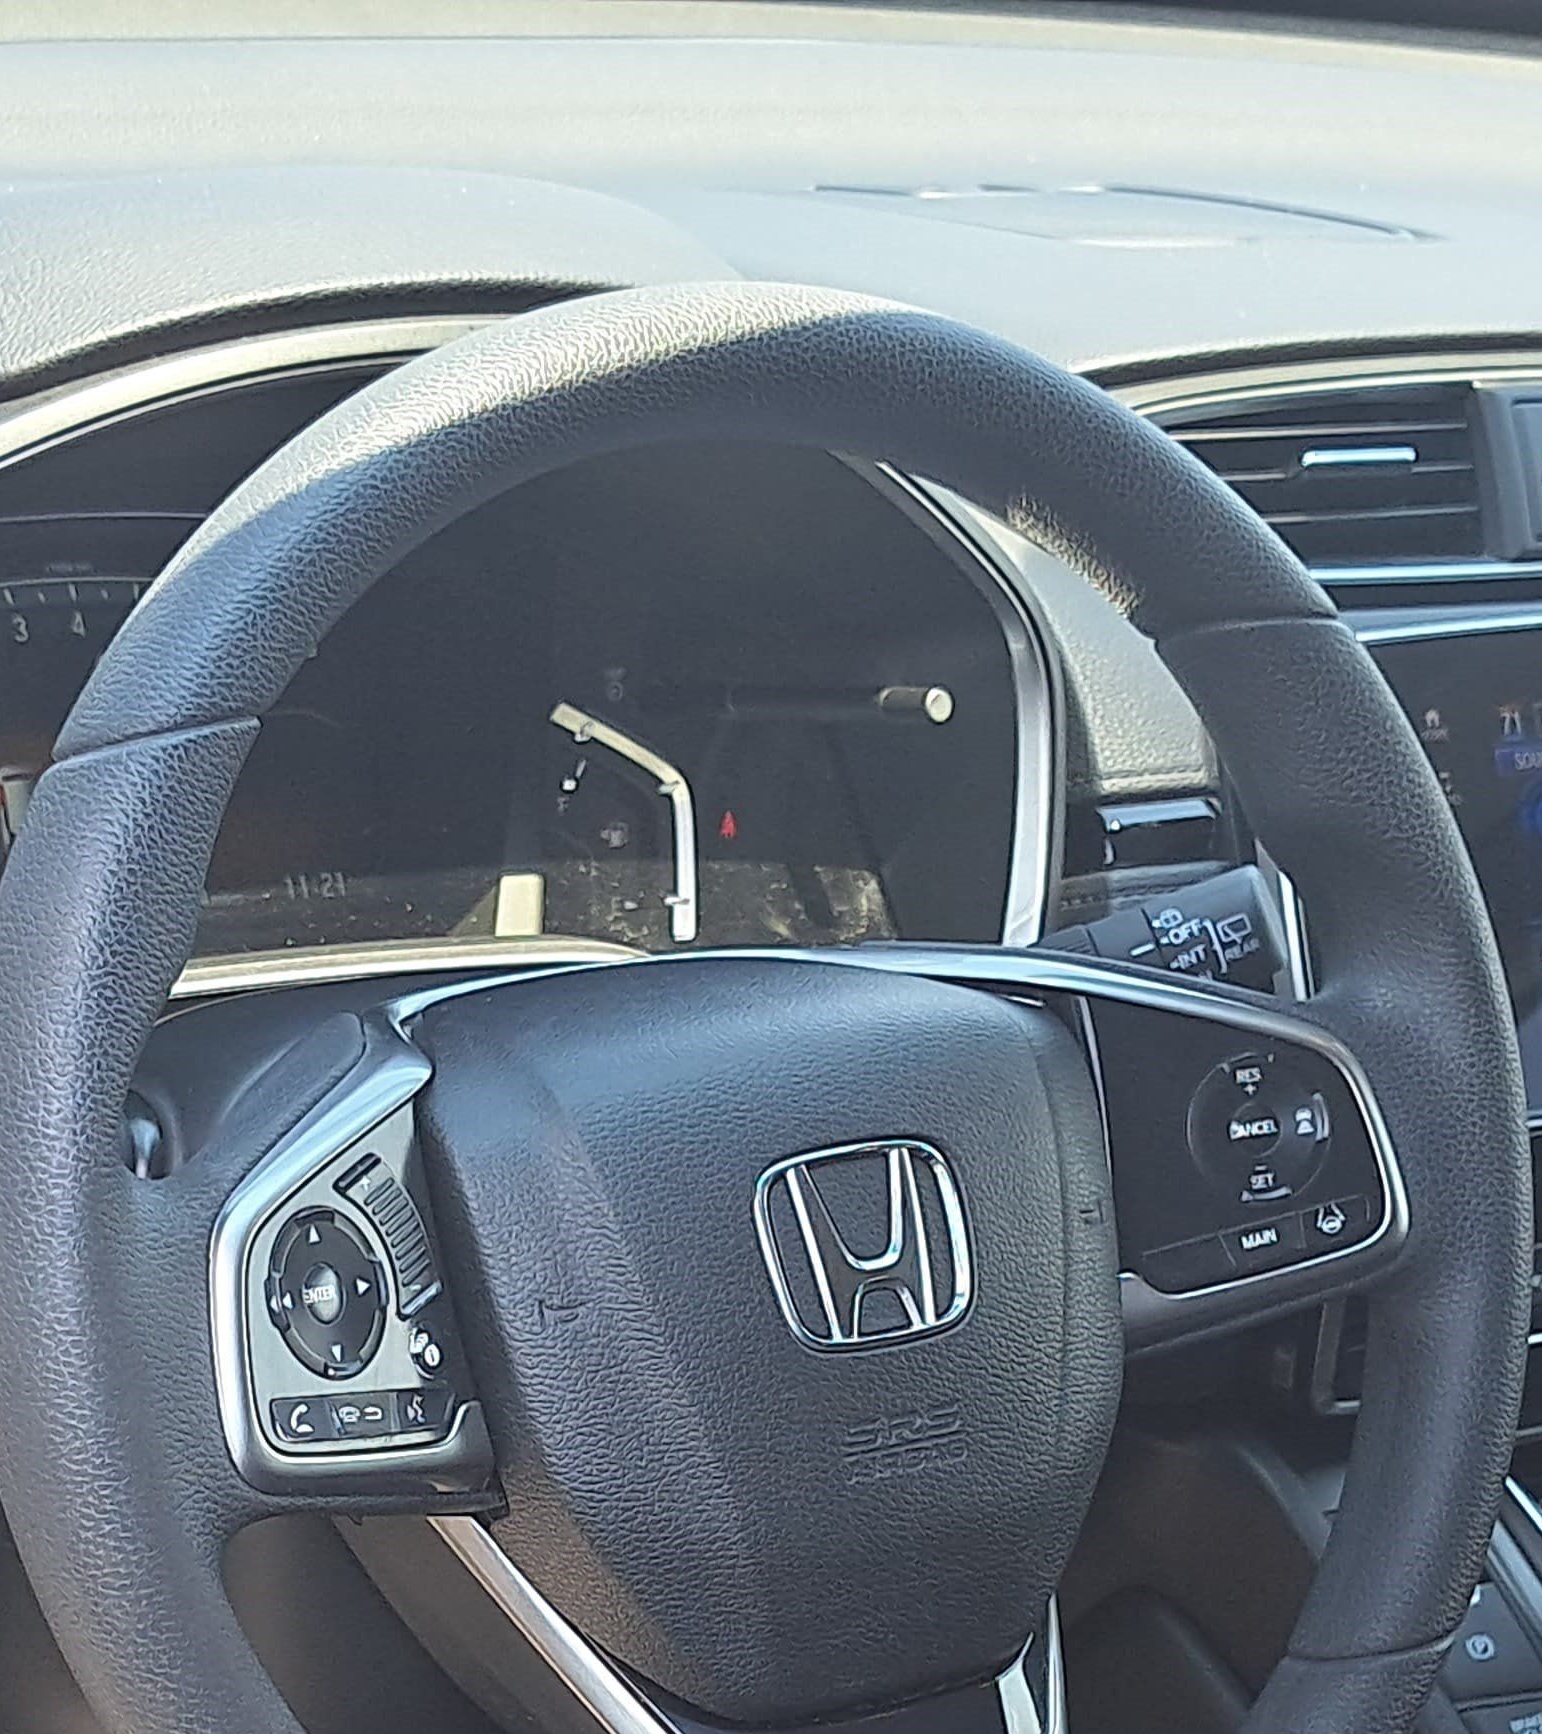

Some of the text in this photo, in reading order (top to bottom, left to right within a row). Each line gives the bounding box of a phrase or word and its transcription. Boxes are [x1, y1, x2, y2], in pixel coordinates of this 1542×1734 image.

[12, 614, 29, 643] 3
[71, 610, 86, 637] 4
[1169, 917, 1205, 945] OFF
[1178, 943, 1207, 970] INT
[1234, 1067, 1262, 1084] RES
[1228, 1118, 1279, 1141] CANCEL
[1249, 1172, 1277, 1190] SET
[1240, 1227, 1279, 1250] MAIN
[303, 1284, 336, 1305] ENTER
